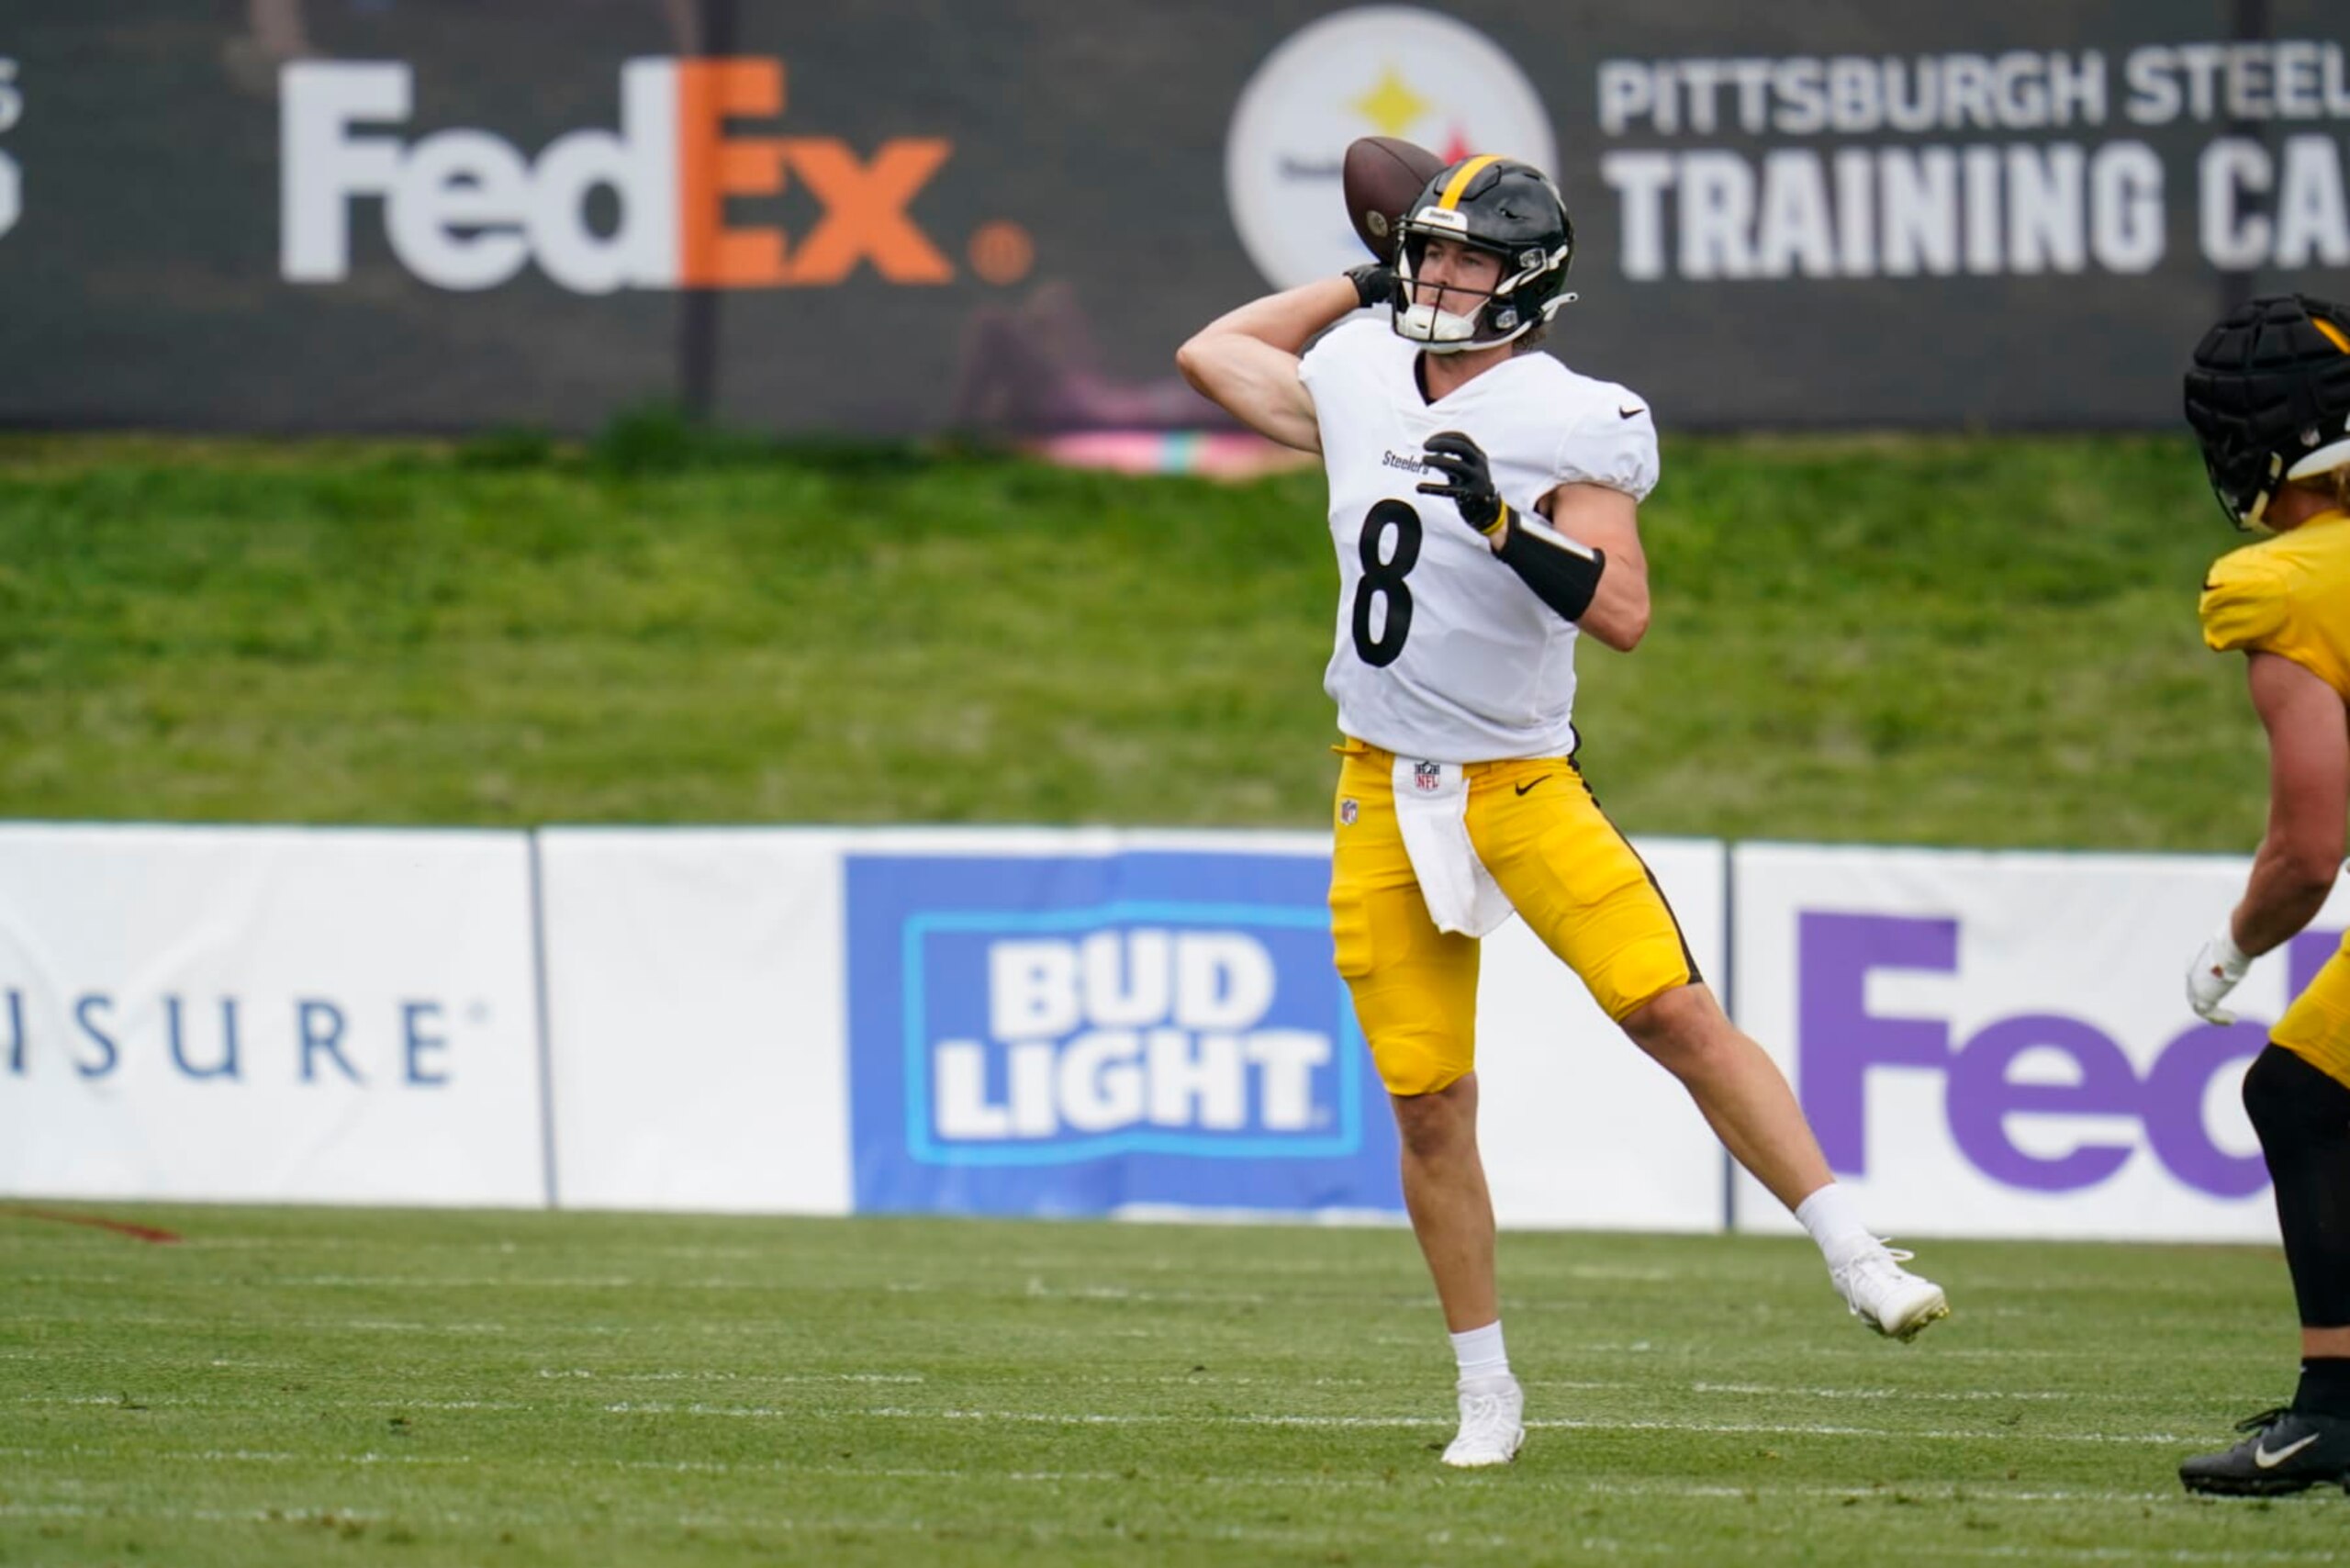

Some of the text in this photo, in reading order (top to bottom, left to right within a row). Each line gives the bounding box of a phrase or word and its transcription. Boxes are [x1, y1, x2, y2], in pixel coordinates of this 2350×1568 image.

[1599, 42, 2350, 134] PITTSBURGH STEEL
[281, 58, 955, 291] FedEx
[1602, 138, 2350, 279] TRAINING CA
[1382, 450, 1429, 475] Steelers
[1352, 498, 1422, 667] 8
[1416, 775, 1439, 790] NFL
[990, 930, 1274, 1041] BUD
[935, 1028, 1330, 1138] LIGHT
